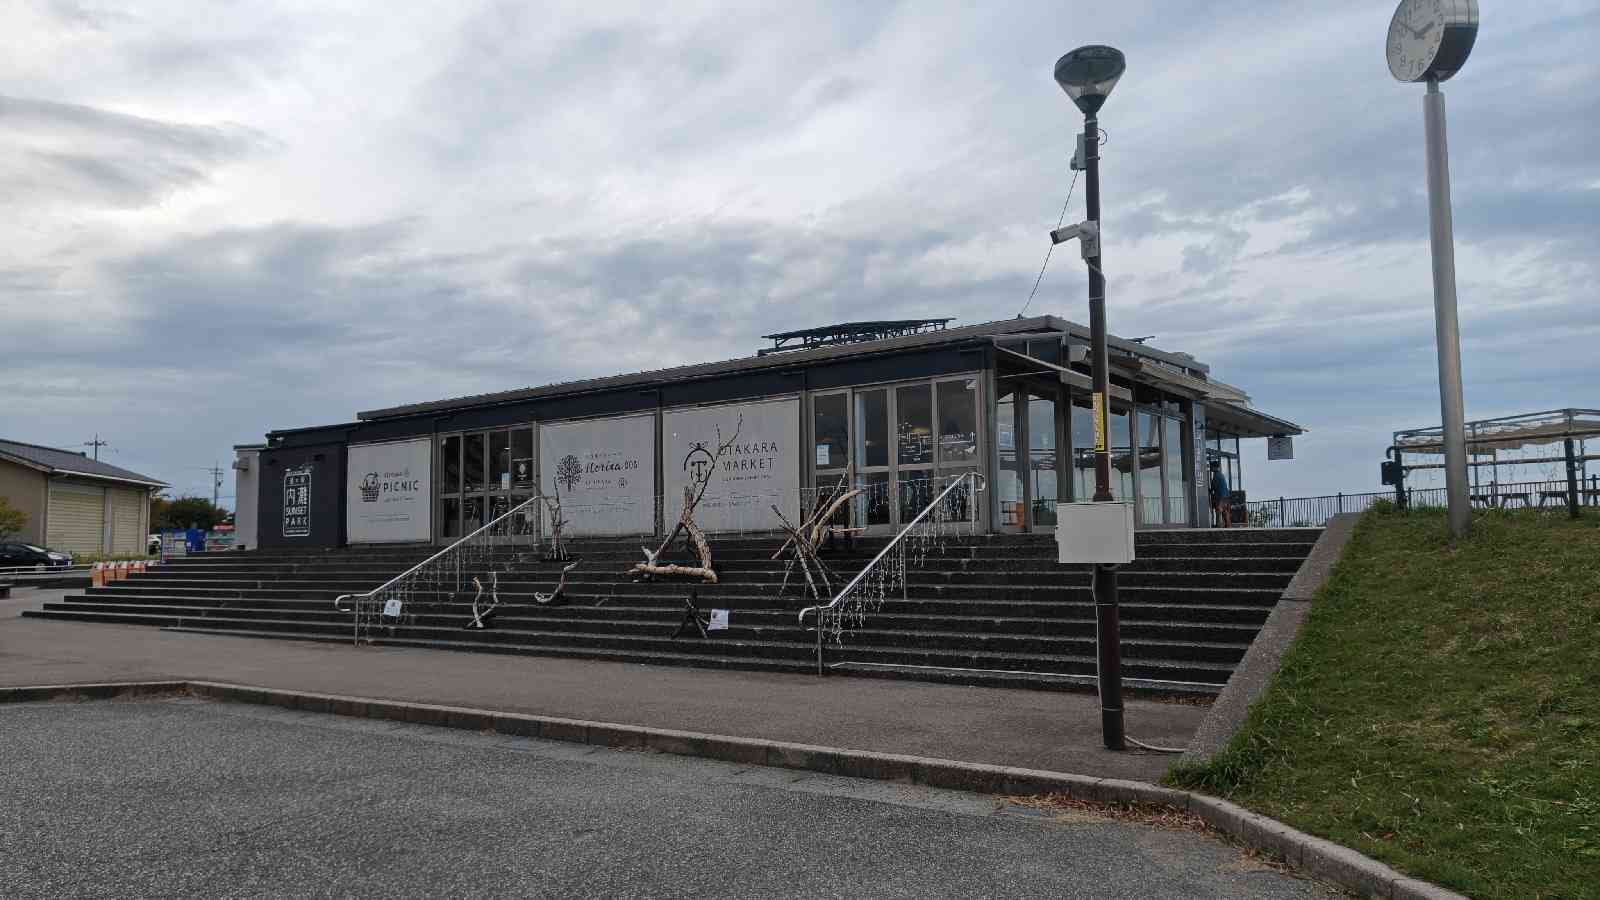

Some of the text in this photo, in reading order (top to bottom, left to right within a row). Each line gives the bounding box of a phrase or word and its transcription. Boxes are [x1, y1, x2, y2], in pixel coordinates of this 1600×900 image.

[722, 457, 776, 472] MARKET
[383, 479, 419, 493] PICNIC
[286, 516, 307, 527] PARK
